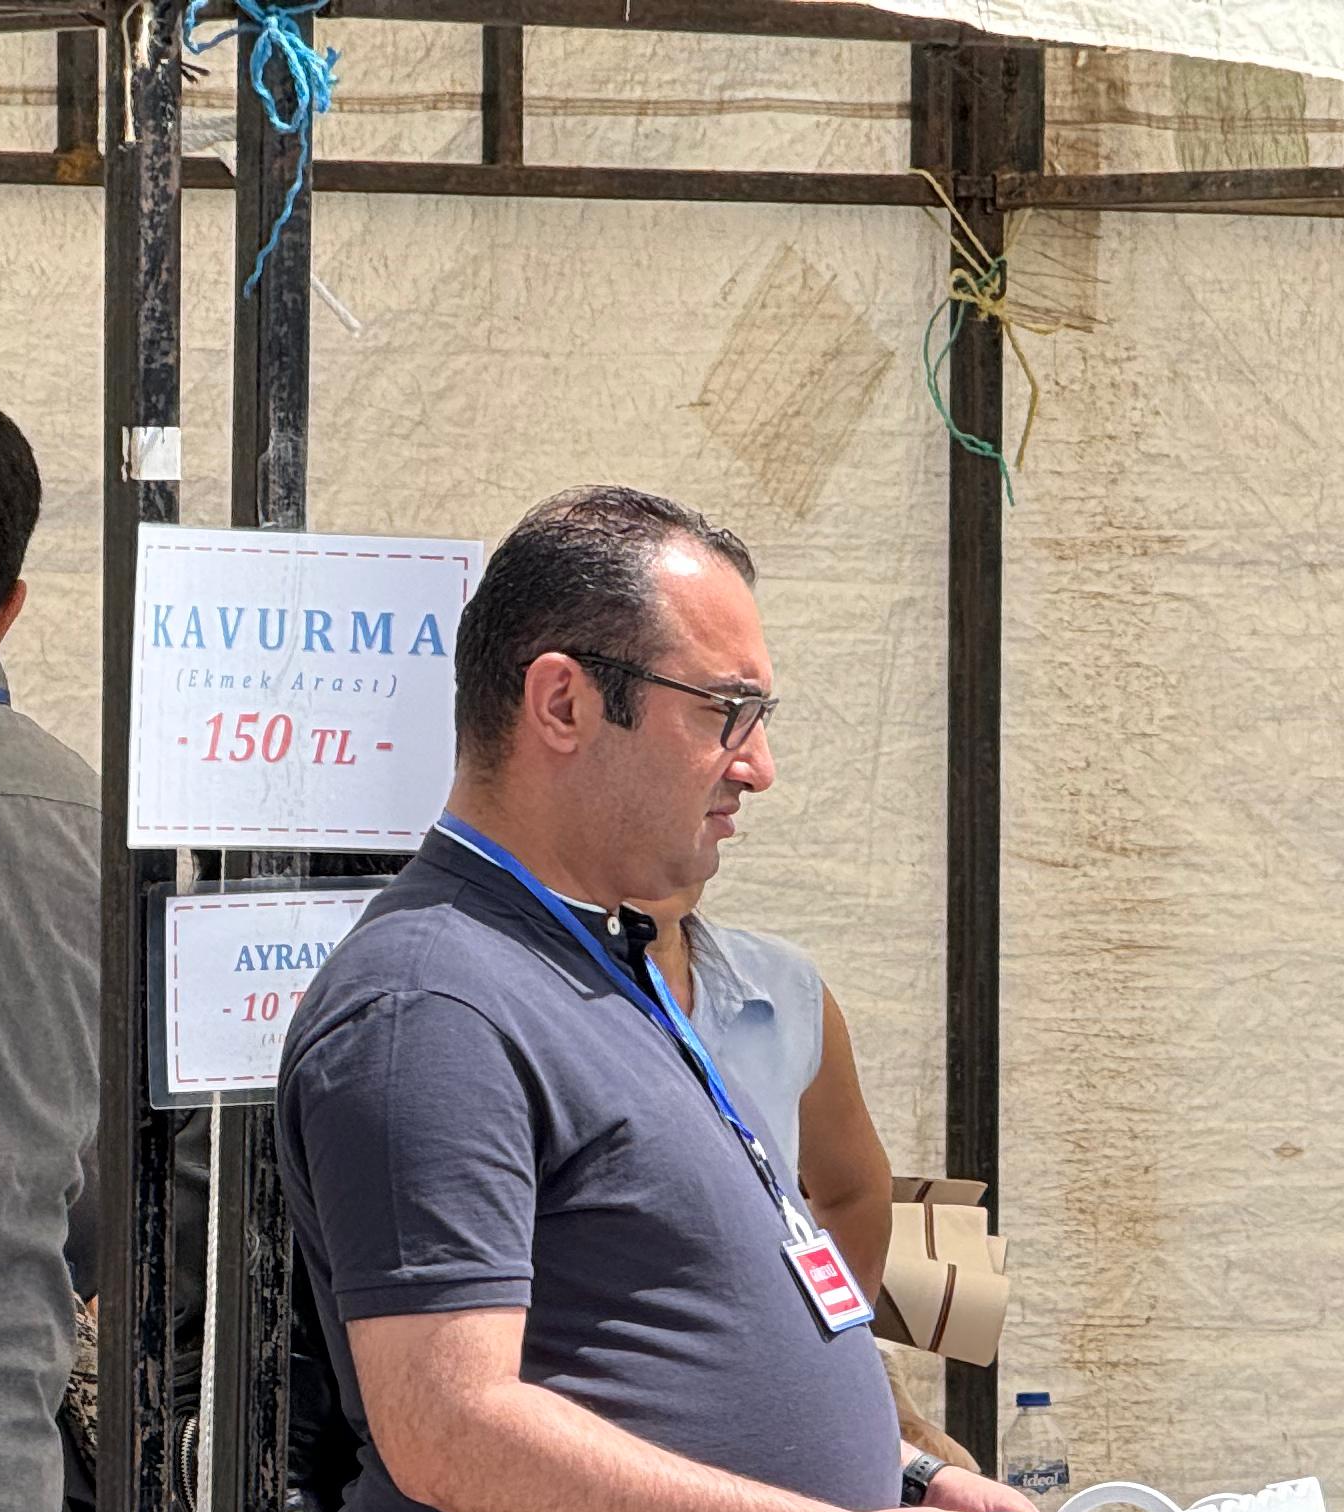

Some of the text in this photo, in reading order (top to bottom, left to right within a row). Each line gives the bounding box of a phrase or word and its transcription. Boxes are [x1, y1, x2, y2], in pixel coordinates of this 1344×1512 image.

[152, 604, 449, 657] KAVURMA
[176, 668, 398, 698] (Ekmek Arası)
[201, 711, 294, 763] 150
[311, 728, 357, 765] TL
[234, 941, 335, 972] AYRAN
[241, 992, 280, 1022] 10
[1022, 1472, 1059, 1487] ideal
